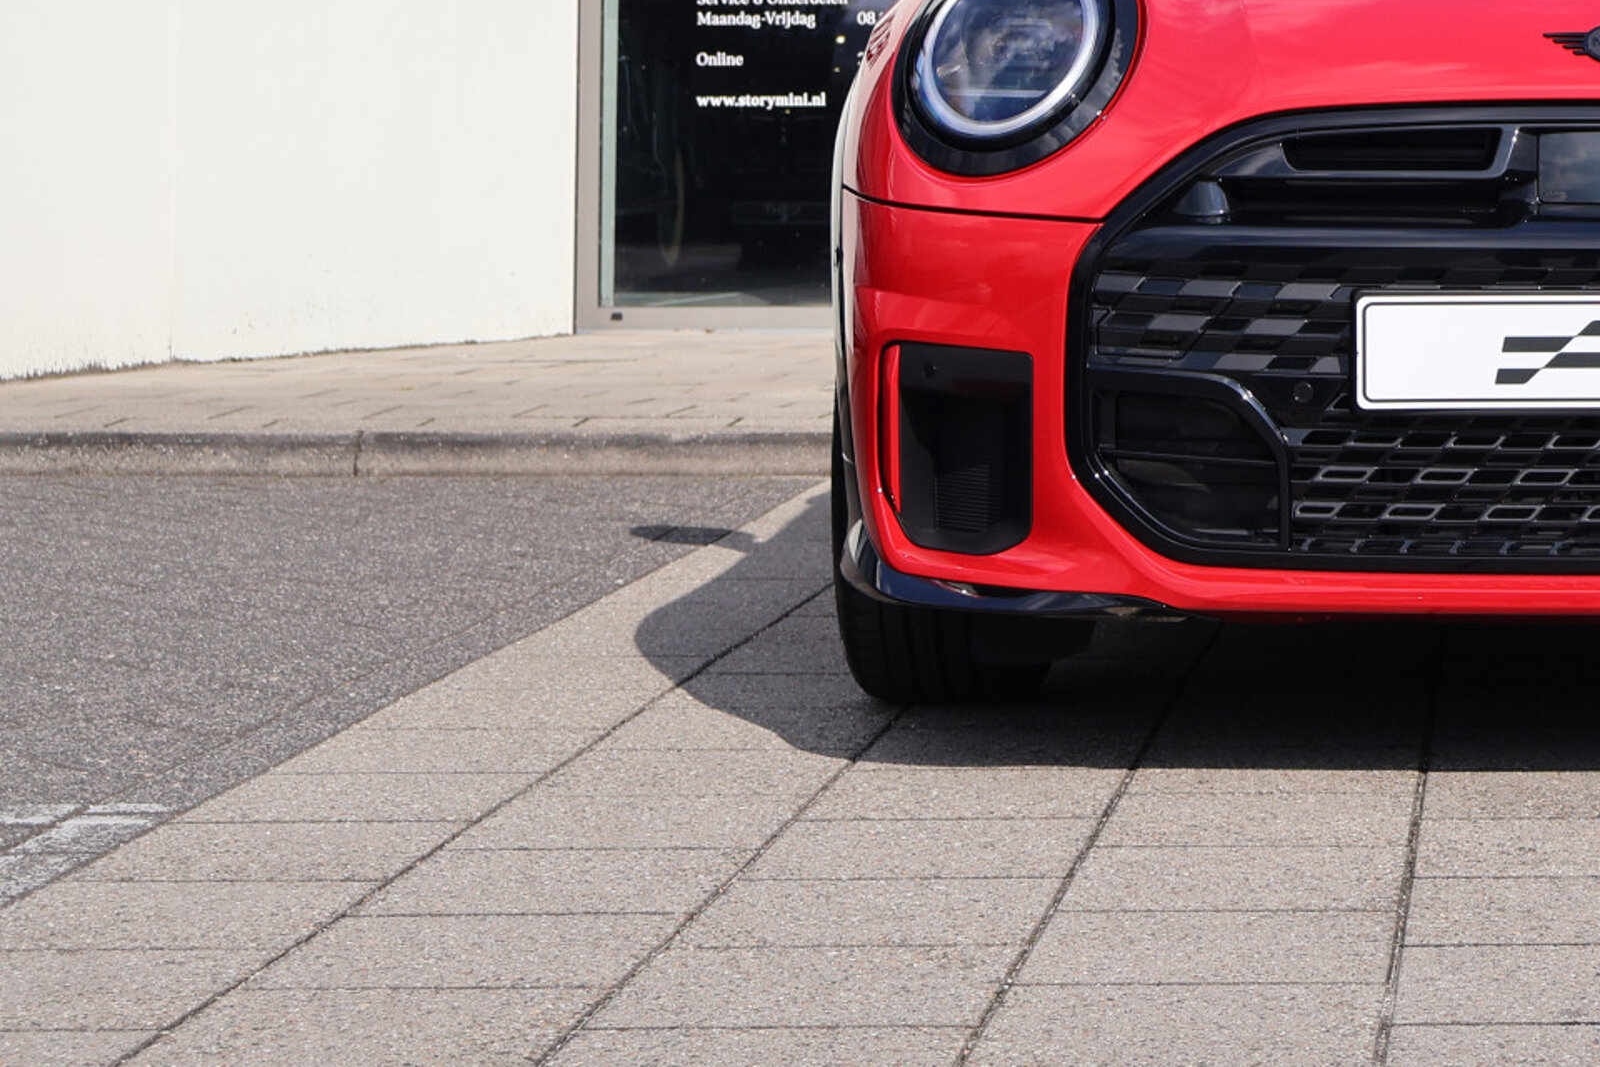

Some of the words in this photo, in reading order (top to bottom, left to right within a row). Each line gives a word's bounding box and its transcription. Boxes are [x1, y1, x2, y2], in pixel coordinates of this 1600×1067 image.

[697, 11, 816, 29] Maandag-Vrijdag
[697, 52, 744, 67] Online
[697, 92, 826, 110] www.storymini.nl
